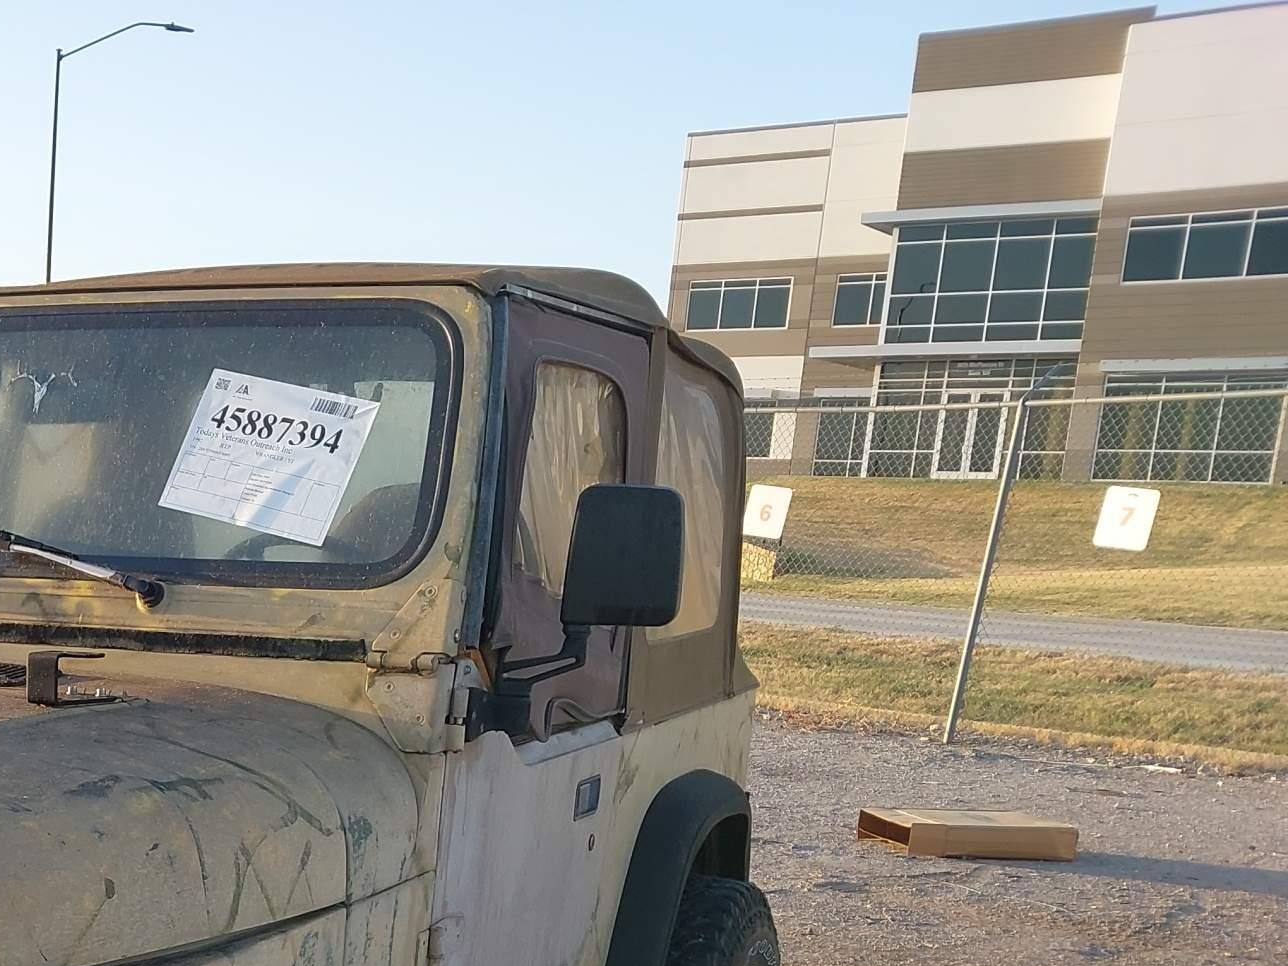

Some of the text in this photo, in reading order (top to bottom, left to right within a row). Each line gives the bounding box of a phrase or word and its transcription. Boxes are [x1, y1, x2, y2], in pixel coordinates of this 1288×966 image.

[195, 426, 219, 438] Todays
[221, 432, 249, 445] Veterans
[251, 439, 280, 452] Outreach
[211, 405, 343, 454] 45887394
[760, 505, 773, 521] 6
[1120, 507, 1136, 526] 7
